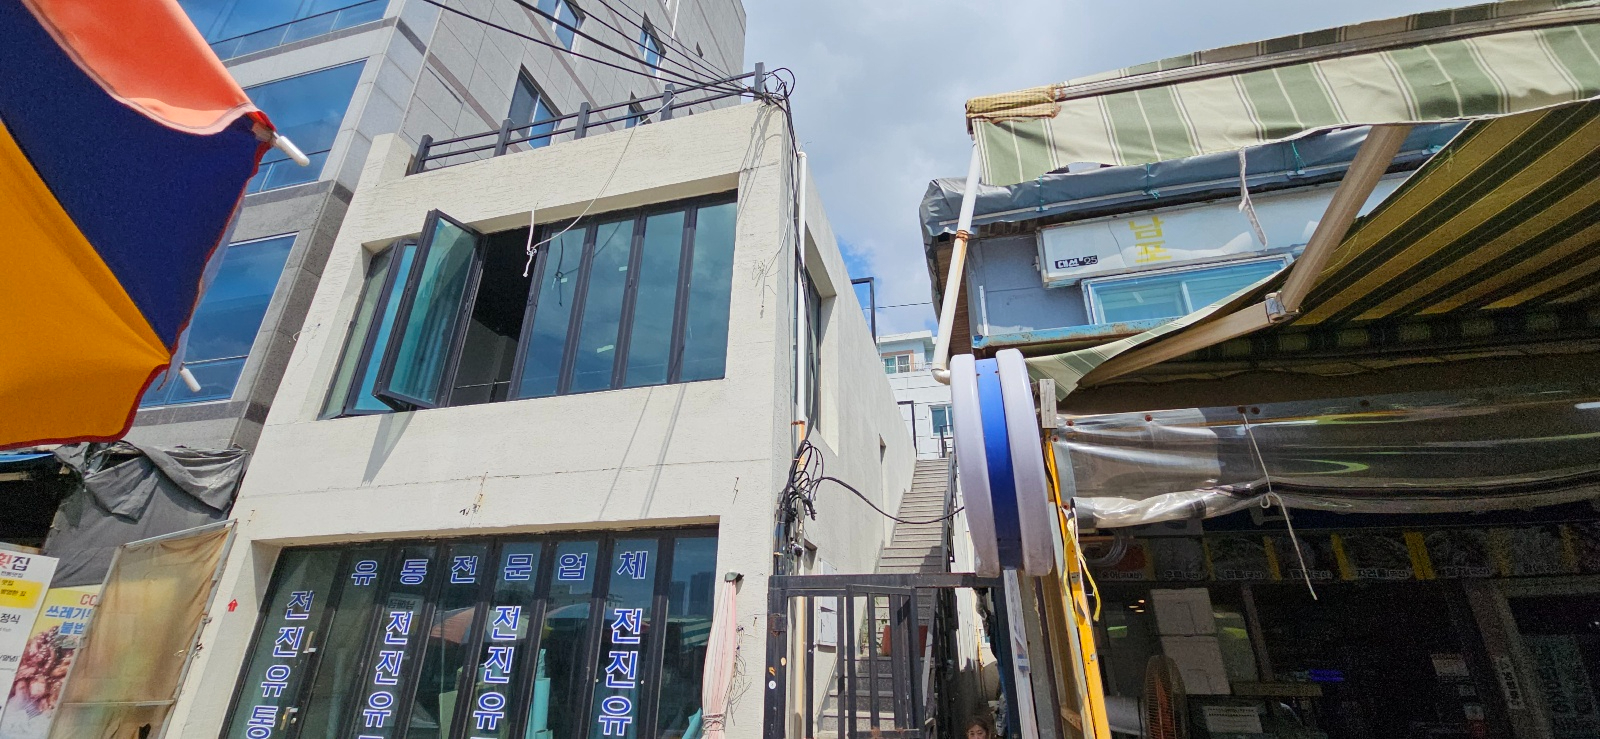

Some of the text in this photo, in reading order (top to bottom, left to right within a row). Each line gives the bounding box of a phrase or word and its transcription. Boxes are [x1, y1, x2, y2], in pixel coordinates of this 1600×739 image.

[45, 605, 93, 620] 쓰레기
[351, 610, 413, 739] 전진유
[470, 605, 521, 739] 전진유
[598, 608, 643, 736] 전진유
